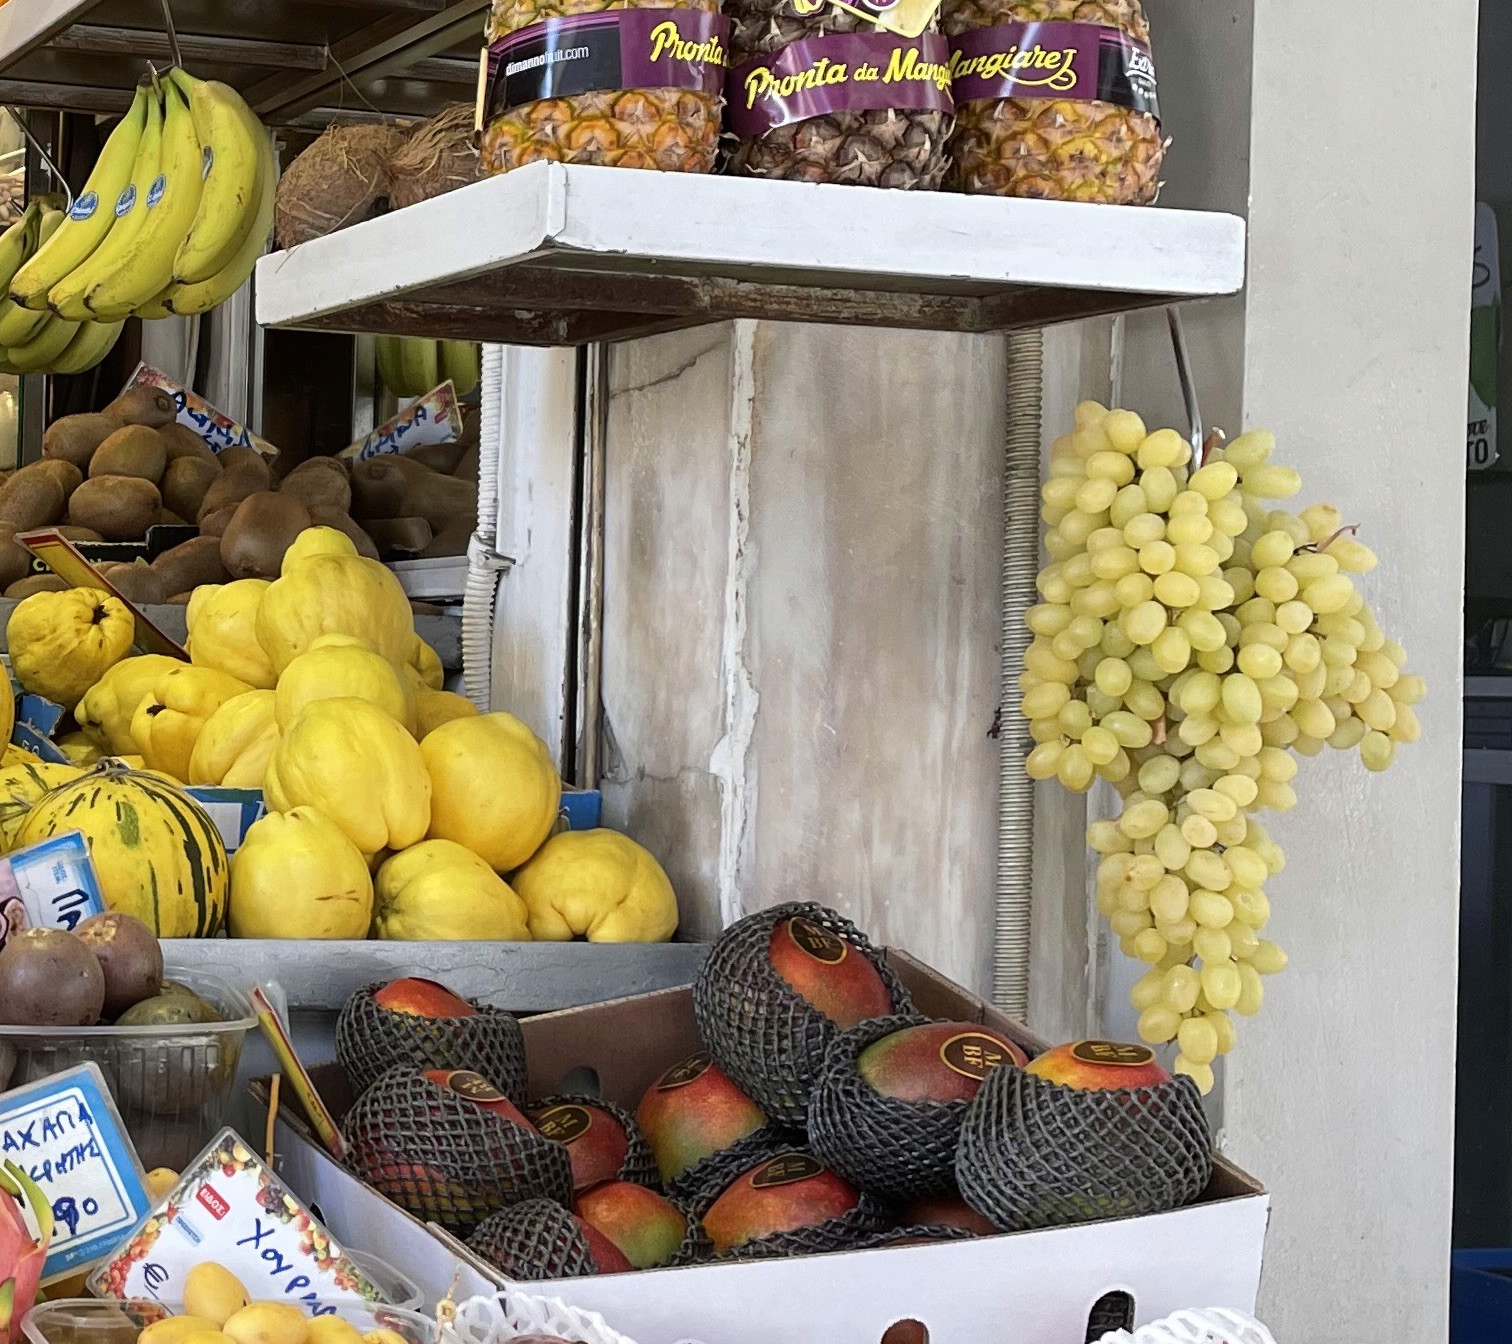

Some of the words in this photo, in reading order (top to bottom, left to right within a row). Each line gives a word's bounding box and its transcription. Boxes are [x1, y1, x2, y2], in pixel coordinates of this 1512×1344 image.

[650, 20, 723, 64] Pronta
[506, 45, 589, 76] dimannofruit.com
[745, 56, 847, 110] Pronta
[854, 62, 879, 82] da
[200, 1187, 226, 1218] ΕΙΔΟΣ
[142, 1262, 169, 1290] €
